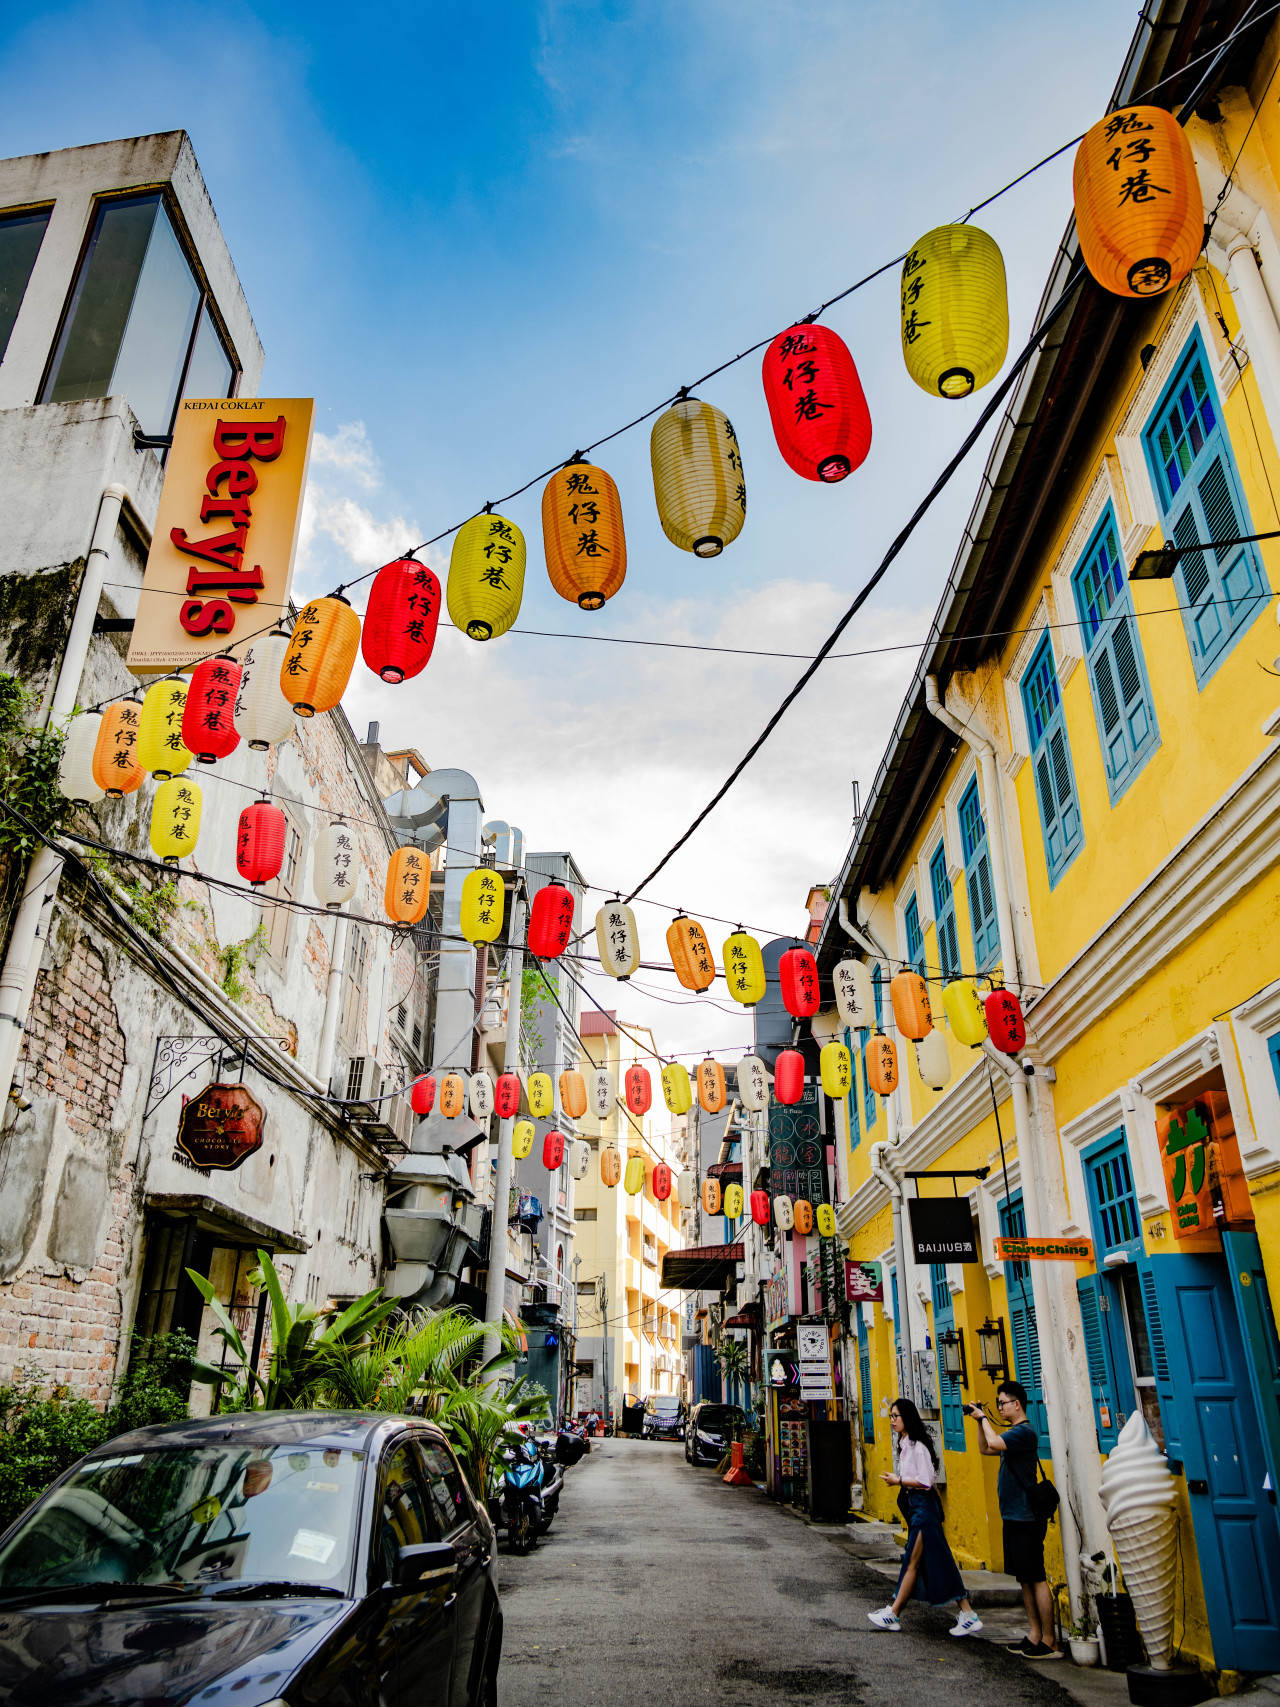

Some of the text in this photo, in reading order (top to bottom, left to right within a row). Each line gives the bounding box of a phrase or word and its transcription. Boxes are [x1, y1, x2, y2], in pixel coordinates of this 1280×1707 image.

[1103, 113, 1172, 208] 鬼仔巷
[902, 250, 932, 346] 鬼仔巷
[779, 333, 835, 425] 鬼仔巷
[184, 401, 265, 411] KEDAI COKLAT
[170, 415, 287, 637] Beryl's
[566, 473, 611, 558] 鬼仔巷
[479, 519, 517, 592] 鬼仔巷
[402, 571, 435, 645] 鬼仔巷
[284, 605, 320, 677] 鬼仔巷
[163, 690, 188, 752] 鬼仔巷
[202, 666, 233, 731] 鬼仔巷
[111, 708, 140, 769] 鬼仔巷
[170, 787, 196, 841] 鬼仔巷
[236, 815, 251, 868] 鬼仔巷
[333, 833, 353, 888] 鬼仔巷
[400, 854, 423, 906] 鬼仔巷
[478, 876, 497, 925] 鬼仔巷
[557, 896, 574, 948] 鬼仔巷
[609, 913, 632, 963] 鬼仔巷
[687, 925, 713, 974] 鬼仔巷
[730, 945, 753, 992] 鬼仔巷
[799, 958, 817, 1005] 鬼仔巷
[839, 968, 863, 1015] 鬼仔巷
[1002, 999, 1022, 1041] 鬼仔巷
[632, 1071, 645, 1105] 鬼仔巷
[703, 1067, 720, 1102] 鬼仔巷
[751, 1063, 767, 1102] 鬼仔巷
[836, 1050, 850, 1087] 鬼仔巷
[881, 1043, 897, 1084] 鬼仔巷
[444, 1080, 455, 1109] 鬼仔巷
[476, 1079, 488, 1110] 鬼仔巷
[501, 1081, 512, 1112] 鬼仔巷
[533, 1079, 545, 1109] 鬼仔巷
[596, 1076, 609, 1110] 鬼仔巷
[1176, 1202, 1198, 1217] Ching
[1178, 1214, 1200, 1229] Ching
[686, 1303, 694, 1331] HOTEL
